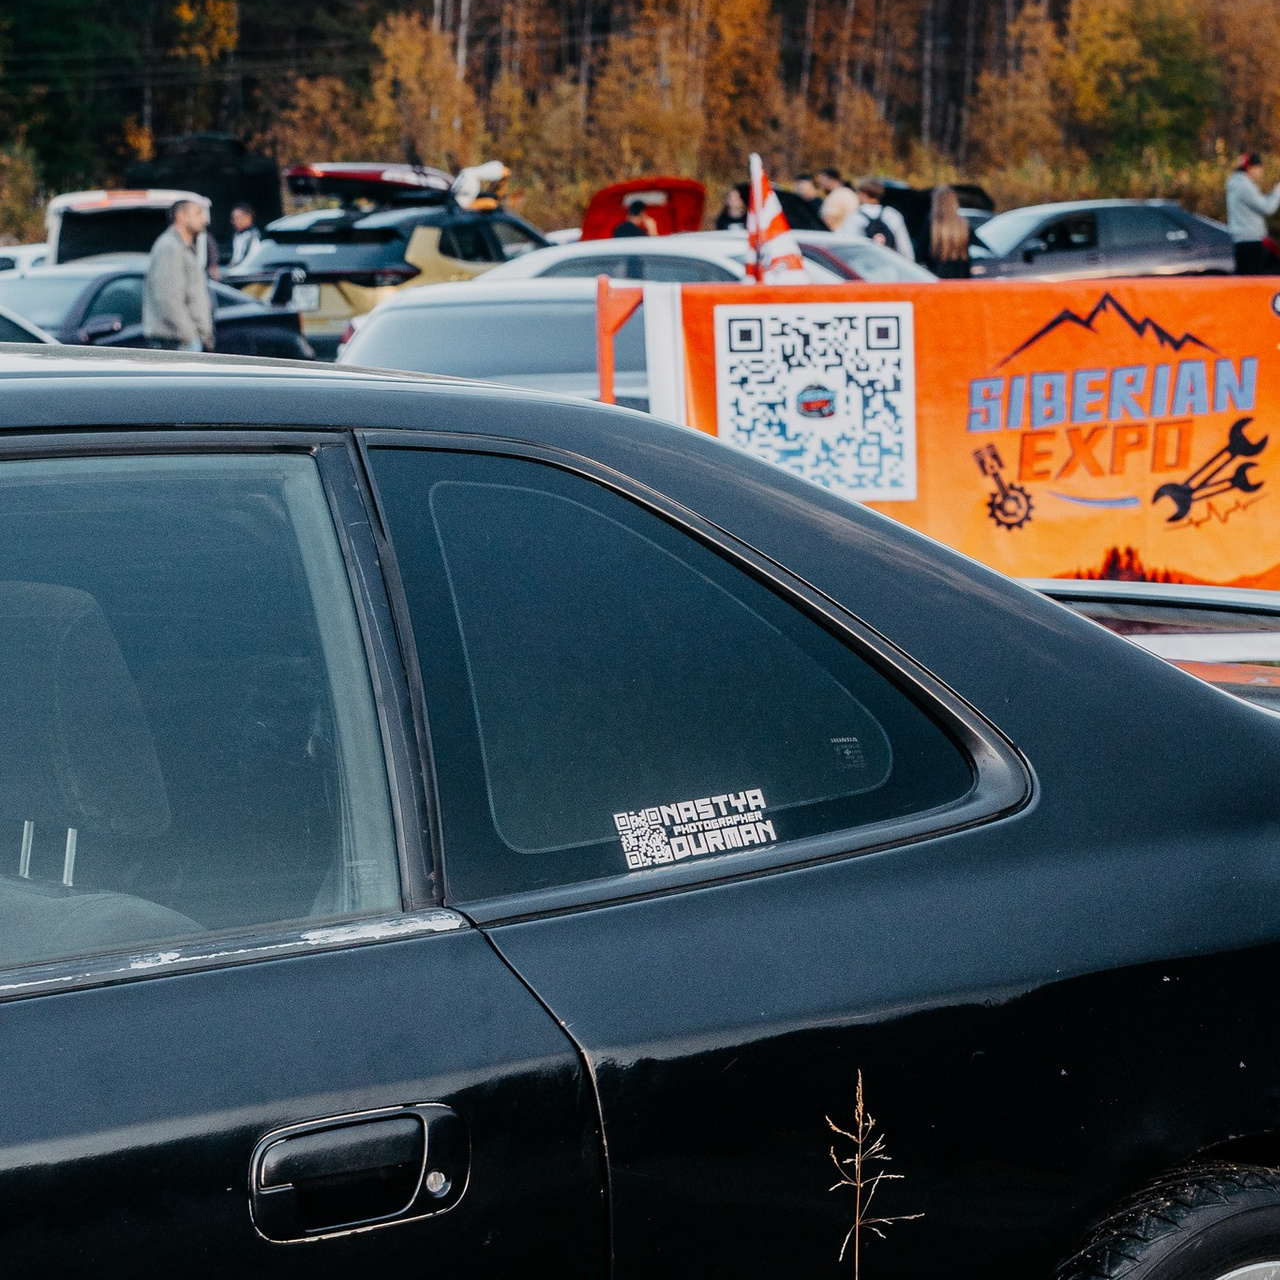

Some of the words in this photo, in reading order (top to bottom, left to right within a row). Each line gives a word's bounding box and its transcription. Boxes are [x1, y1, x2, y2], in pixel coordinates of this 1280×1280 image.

[966, 356, 1259, 434] SIBERIAN
[1017, 419, 1195, 482] EXPO
[660, 788, 767, 827] NASTYA
[673, 811, 764, 837] PHOTOGRAPHER
[670, 819, 778, 861] DURMAN
